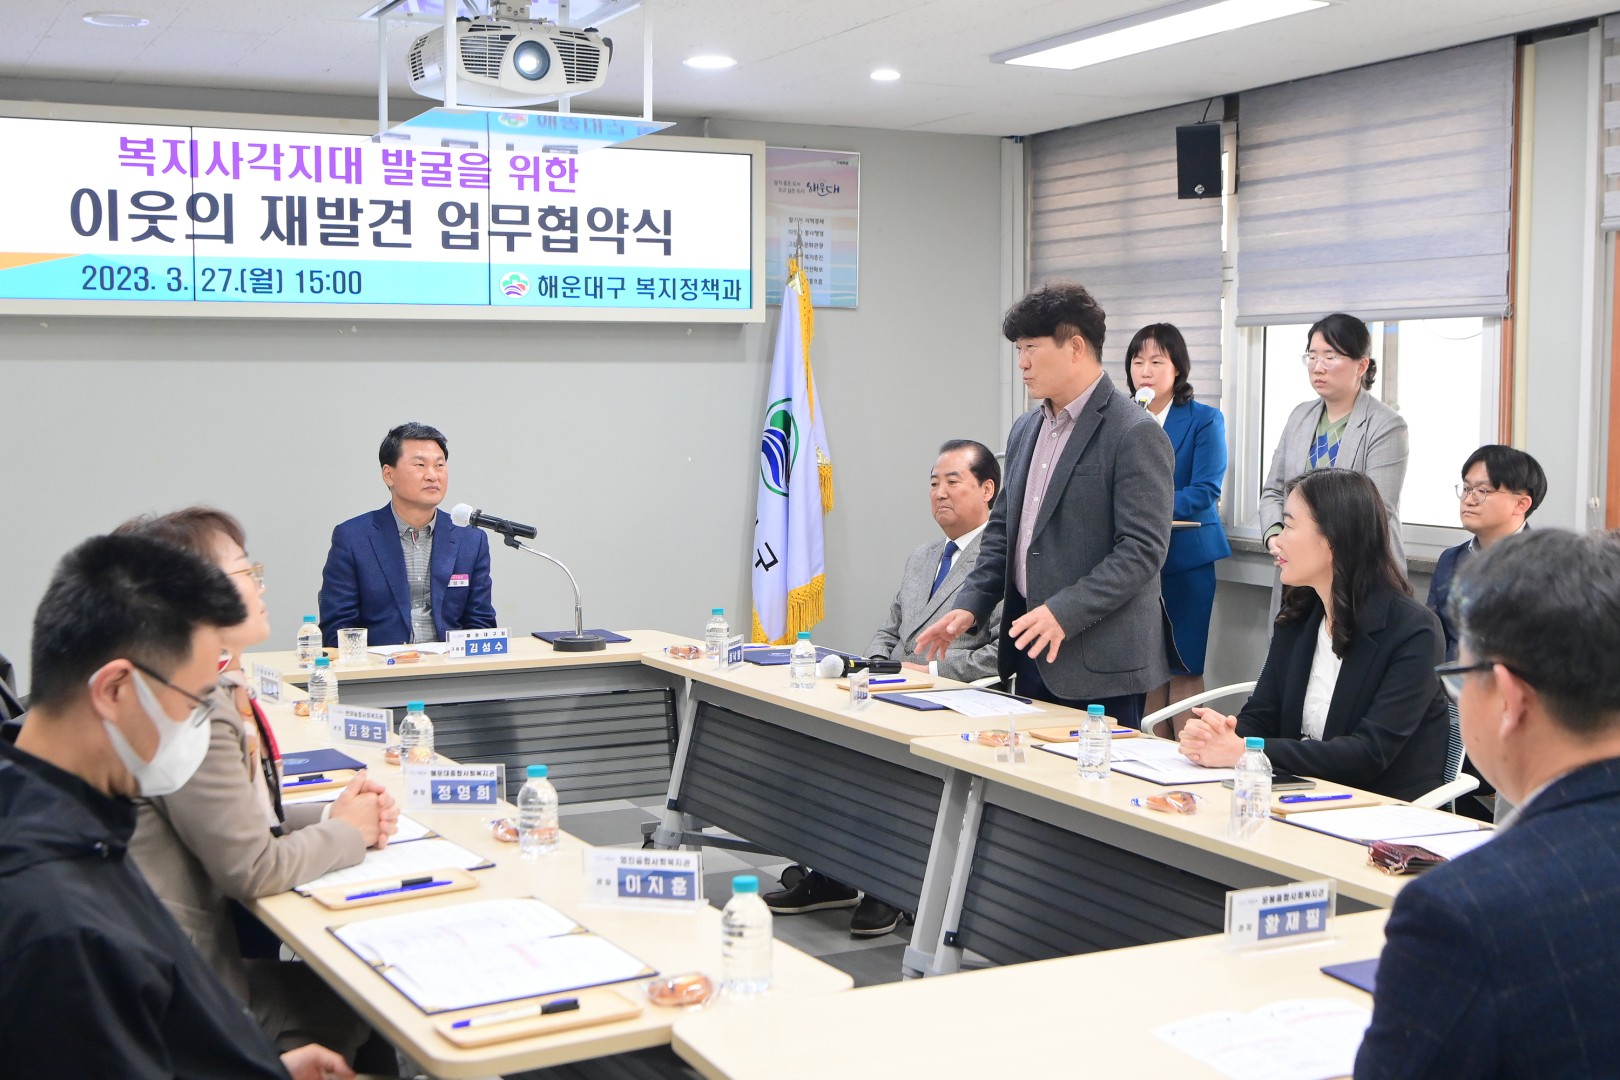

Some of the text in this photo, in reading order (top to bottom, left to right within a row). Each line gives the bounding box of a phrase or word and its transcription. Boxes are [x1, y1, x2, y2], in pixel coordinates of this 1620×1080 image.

[118, 137, 579, 193] 복지사각지대 발굴을 위한
[806, 181, 840, 197] 해운대
[70, 187, 672, 256] 이웃의 재발견 업무협약식
[82, 265, 362, 295] 2023. 3. 27.(월) 15:00
[537, 275, 742, 302] 해운대구 복지정책과
[469, 641, 504, 654] 김성수
[437, 784, 491, 801] 정영희
